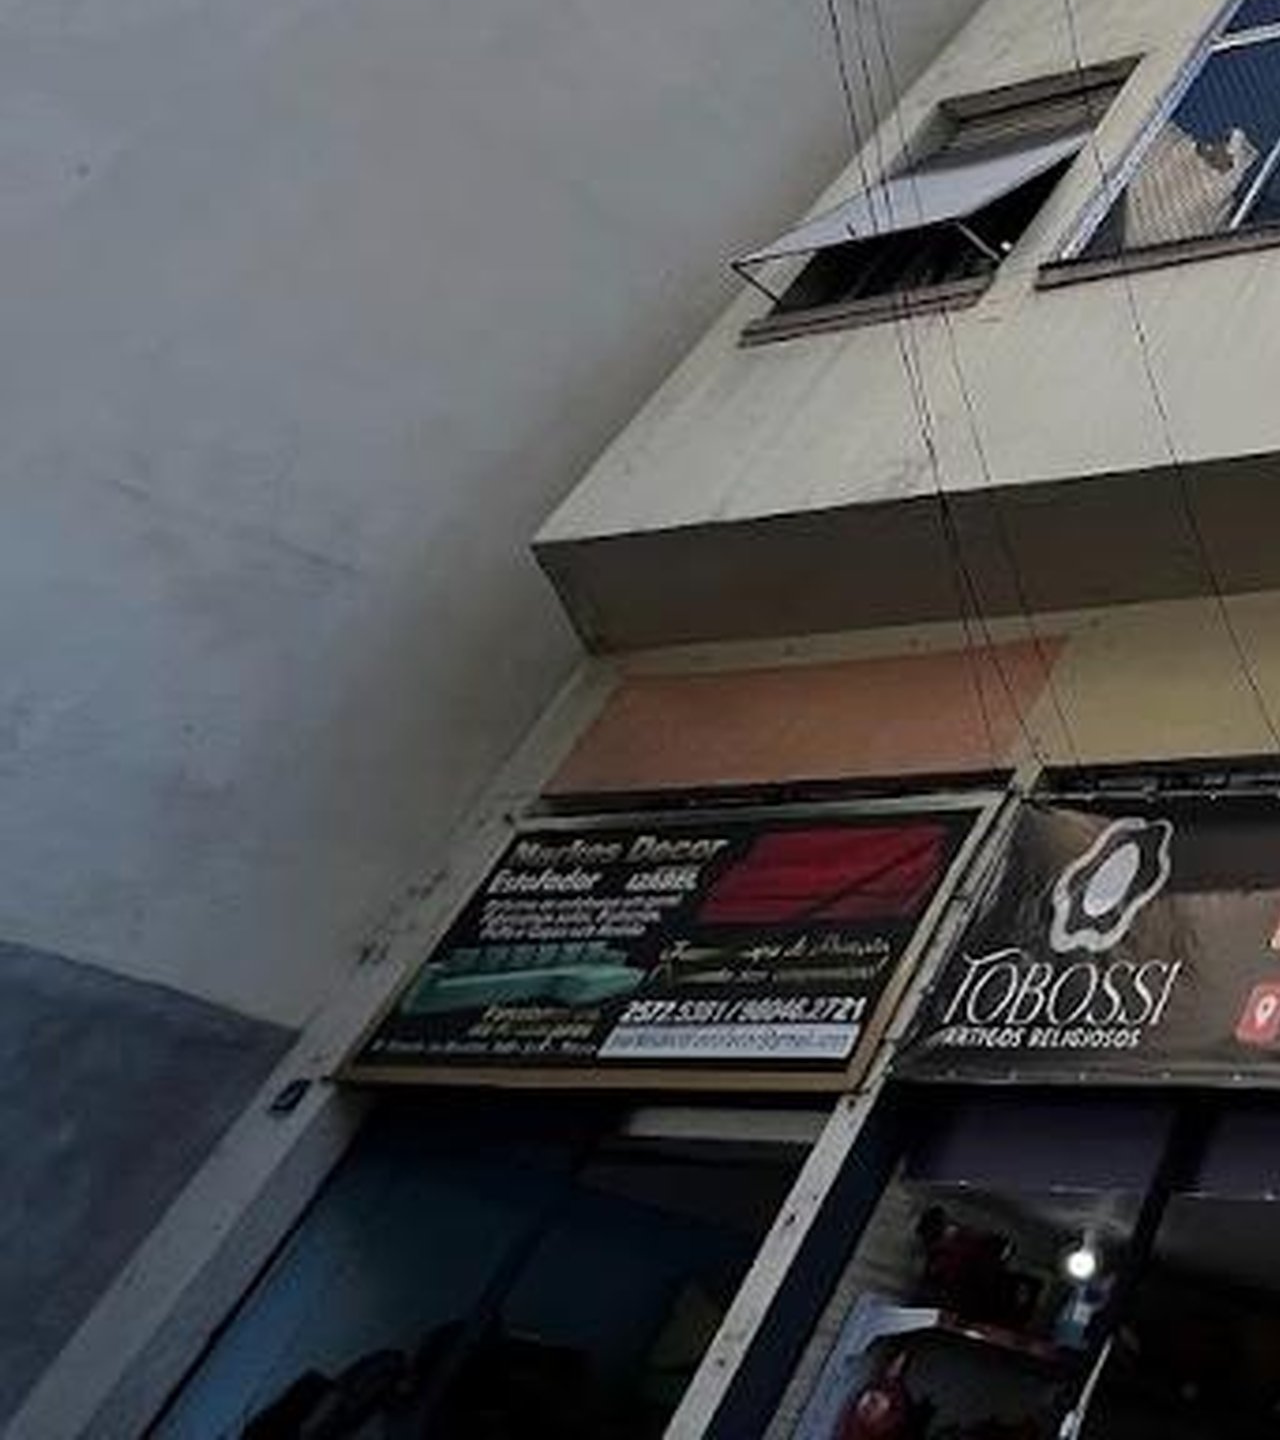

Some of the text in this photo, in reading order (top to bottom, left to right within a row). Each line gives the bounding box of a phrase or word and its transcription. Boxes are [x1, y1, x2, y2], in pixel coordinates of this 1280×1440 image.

[626, 835, 729, 861] Decor
[942, 947, 1182, 1025] TOBOSSI
[944, 1026, 1142, 1048] ARTIGOS RELIGIOSOS
